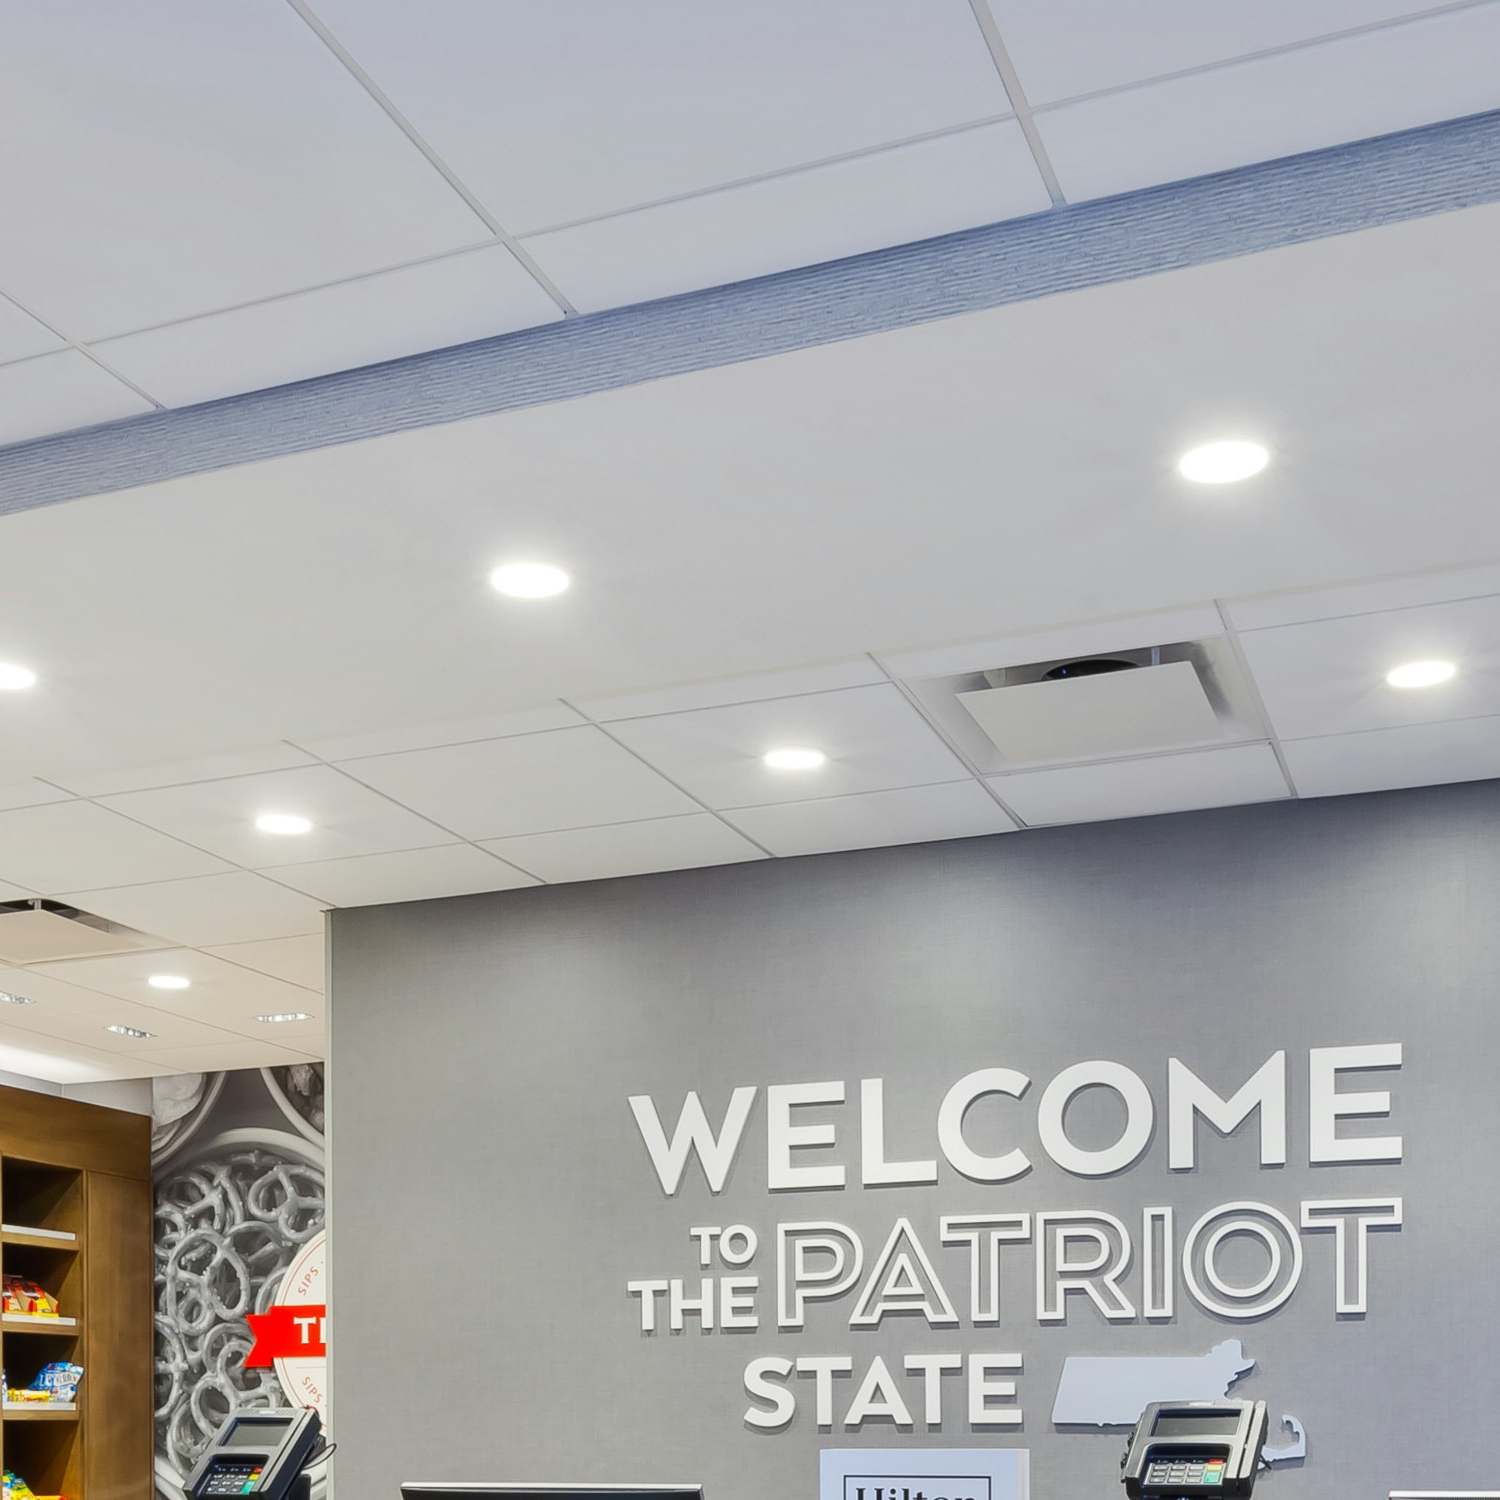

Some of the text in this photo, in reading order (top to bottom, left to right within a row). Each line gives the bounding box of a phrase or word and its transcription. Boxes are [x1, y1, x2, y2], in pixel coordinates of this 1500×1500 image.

[628, 1043, 1403, 1197] WELCOME
[691, 1224, 758, 1266] TO
[776, 1197, 1403, 1328] PATRIOT
[297, 1266, 320, 1296] SIPS
[628, 1276, 760, 1331] THE
[301, 1376, 323, 1403] SIPS
[743, 1353, 1024, 1429] STATE
